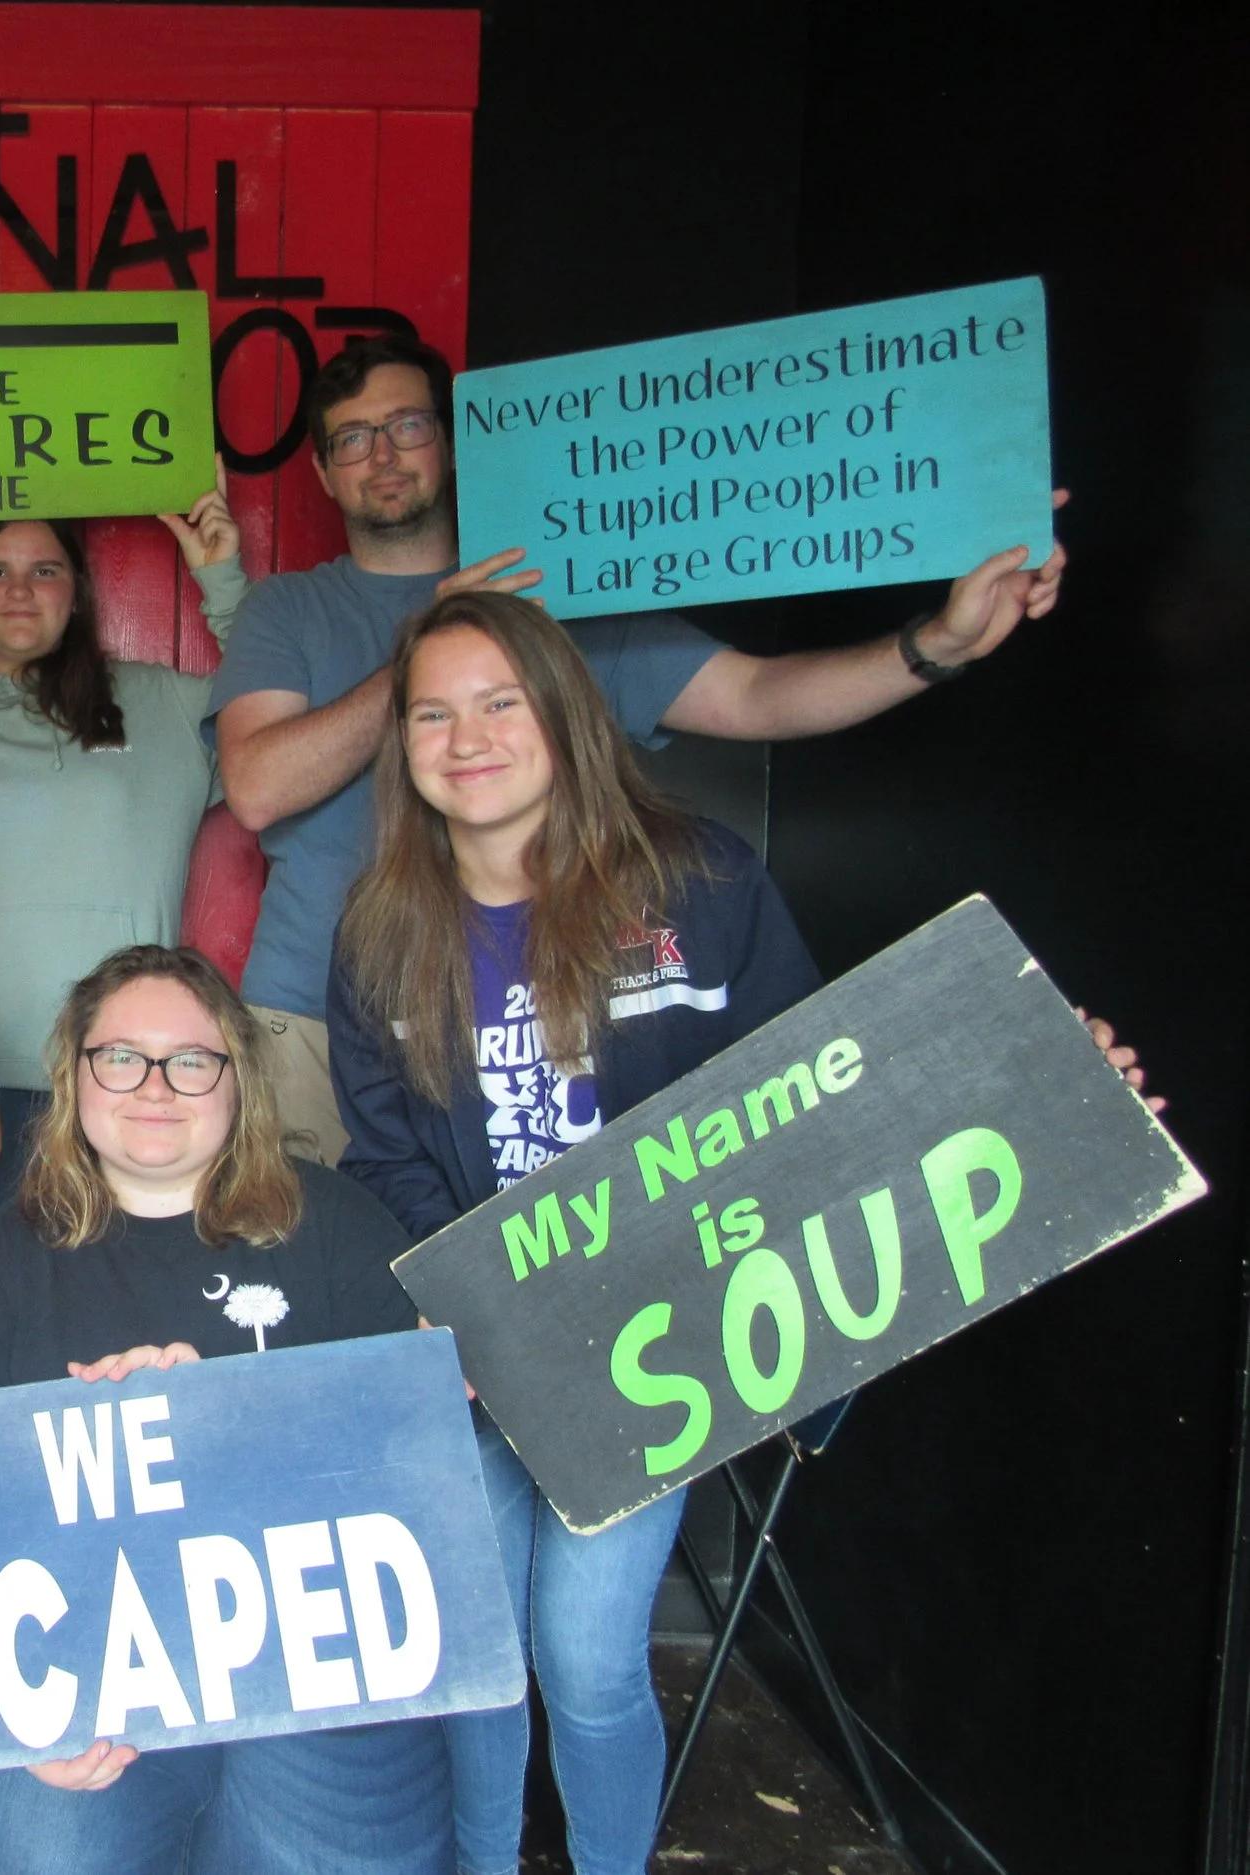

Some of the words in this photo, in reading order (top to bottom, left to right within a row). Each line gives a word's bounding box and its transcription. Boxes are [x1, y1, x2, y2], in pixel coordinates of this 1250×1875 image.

[465, 386, 605, 437] Never
[618, 315, 1026, 413] Underestimate
[565, 434, 646, 479] the
[658, 405, 830, 466] Power
[845, 387, 907, 439] of
[543, 480, 698, 541] Stupid
[712, 459, 880, 519] People
[894, 451, 940, 494] in
[566, 547, 710, 597] Large
[724, 520, 917, 574] Groups
[610, 973, 653, 990] TRACK
[499, 1176, 612, 1283] My
[632, 1037, 863, 1203] Name
[691, 1191, 766, 1269] is
[609, 1127, 1023, 1477] SOUP
[32, 1393, 185, 1526] WE
